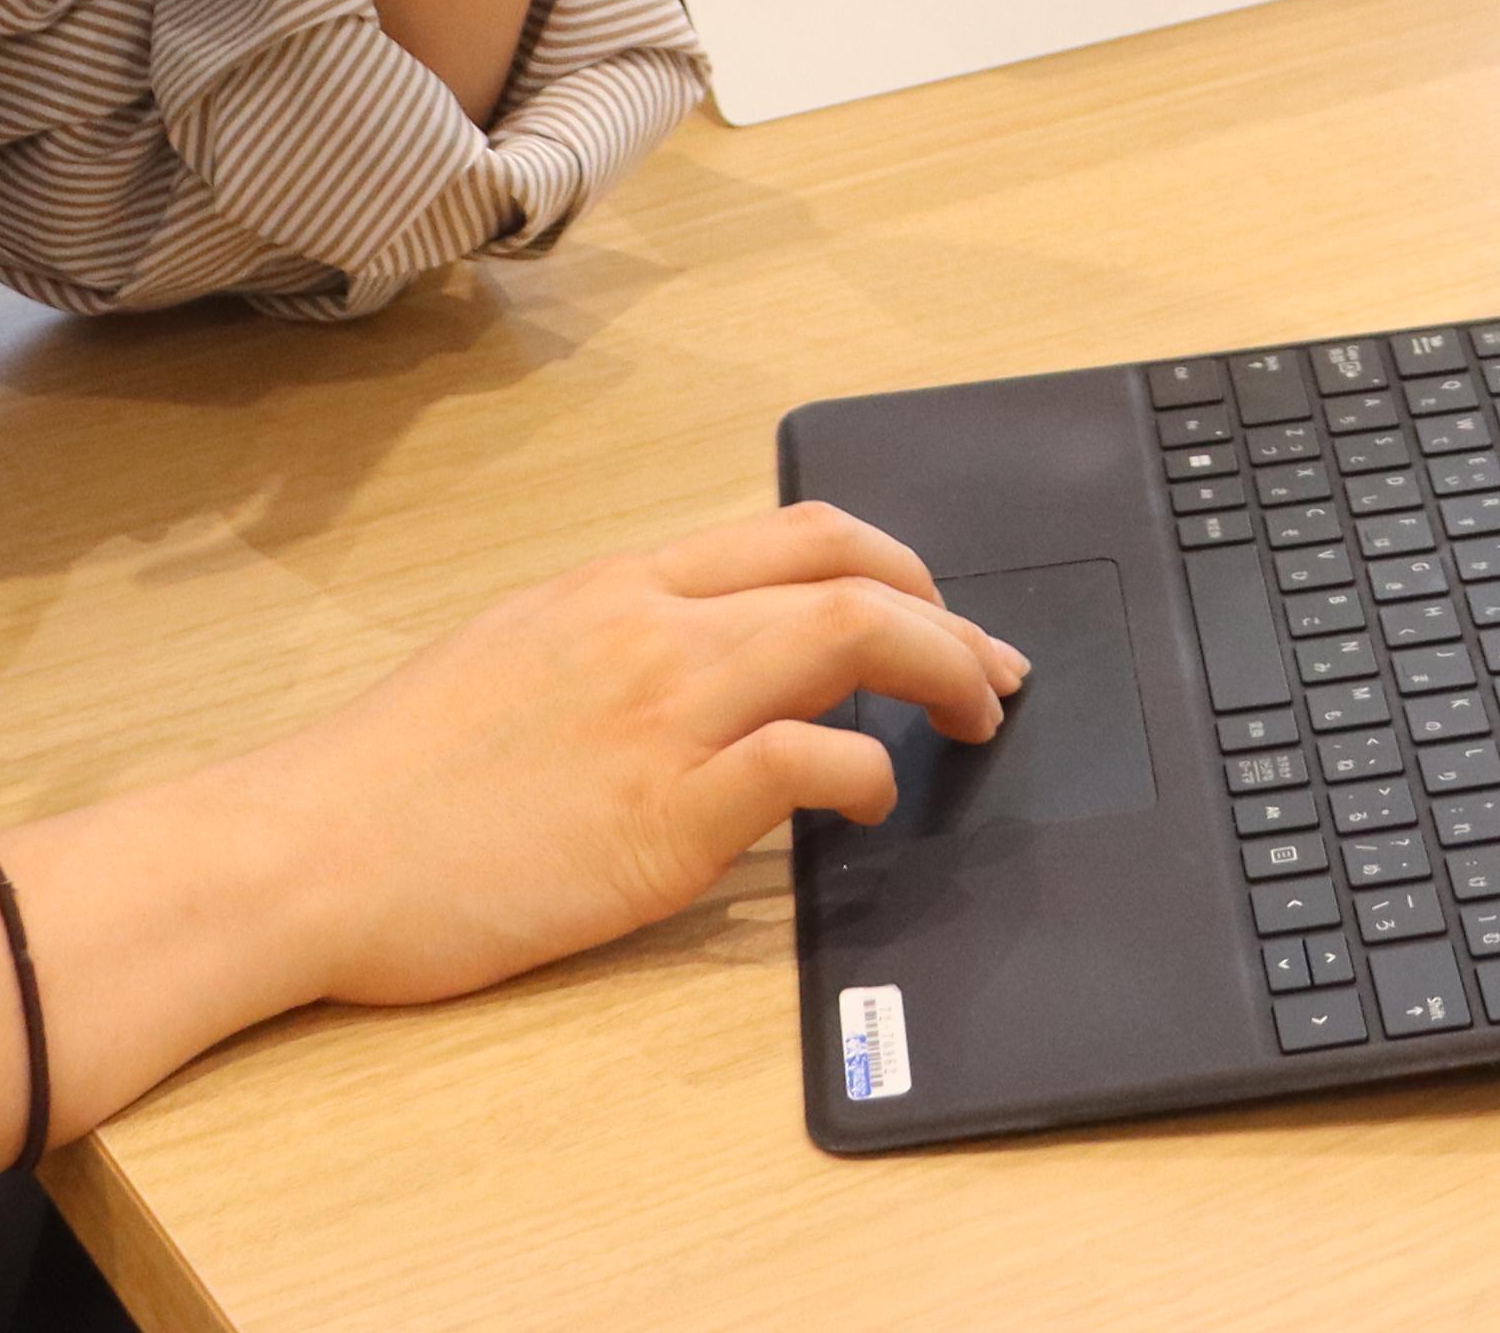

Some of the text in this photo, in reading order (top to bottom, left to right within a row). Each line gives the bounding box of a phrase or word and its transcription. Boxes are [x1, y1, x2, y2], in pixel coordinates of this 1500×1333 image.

[1441, 380, 1462, 390] Q
[1364, 398, 1381, 407] A
[1456, 418, 1475, 430] W
[1285, 428, 1305, 437] Z
[1374, 436, 1394, 445] S
[1468, 457, 1487, 465] E
[1297, 468, 1315, 477] X
[1386, 476, 1405, 486] D
[1482, 498, 1500, 507] R
[1306, 508, 1325, 517] C
[1398, 518, 1417, 526] F
[1317, 549, 1335, 559] V
[1411, 562, 1431, 572] G
[1328, 595, 1348, 605] B
[1424, 606, 1443, 617] H
[1341, 641, 1359, 652] N
[1352, 686, 1371, 700] M
[1451, 698, 1470, 708] K
[1464, 748, 1483, 758] L
[1265, 806, 1281, 820] Alt
[1426, 996, 1445, 1021] Shift
